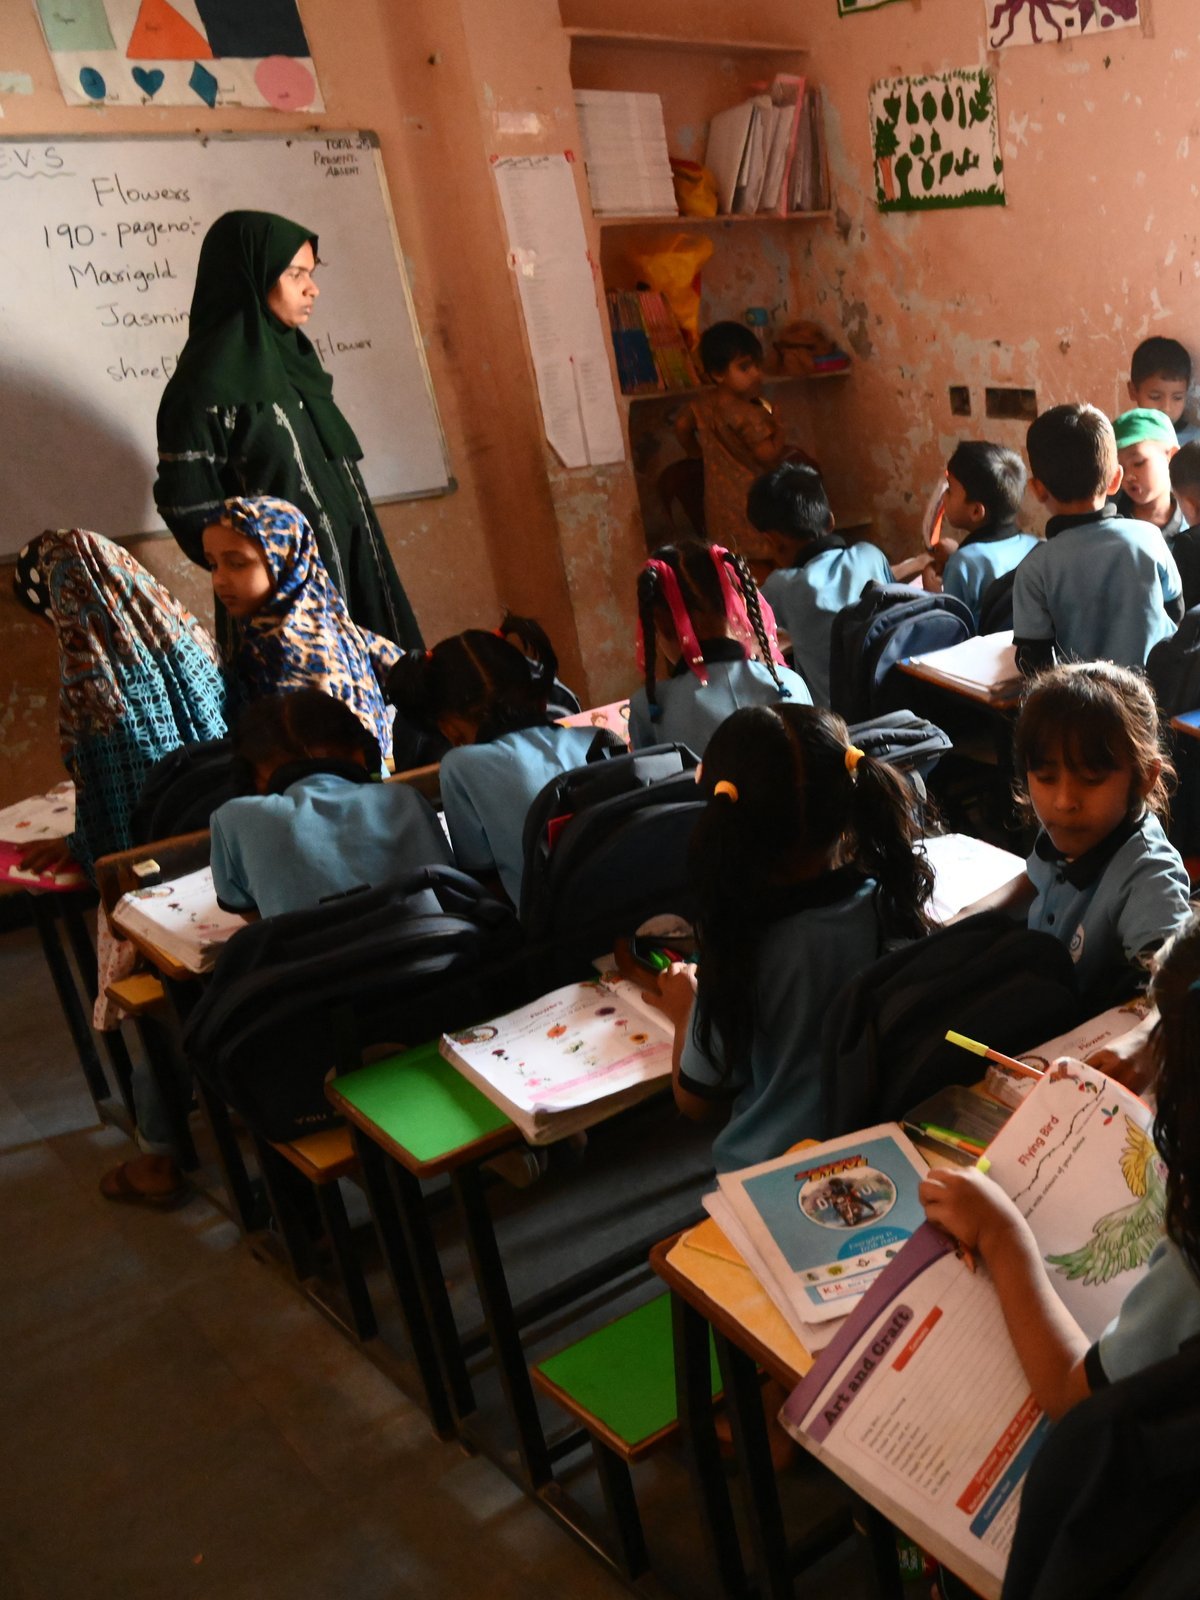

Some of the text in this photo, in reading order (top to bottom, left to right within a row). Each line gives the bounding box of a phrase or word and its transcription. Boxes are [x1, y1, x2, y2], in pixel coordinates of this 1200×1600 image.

[91, 173, 191, 207] Flowers
[68, 257, 177, 293] Marigold
[1018, 1113, 1060, 1167] Flying Bird
[823, 1310, 910, 1427] Art and Craft
